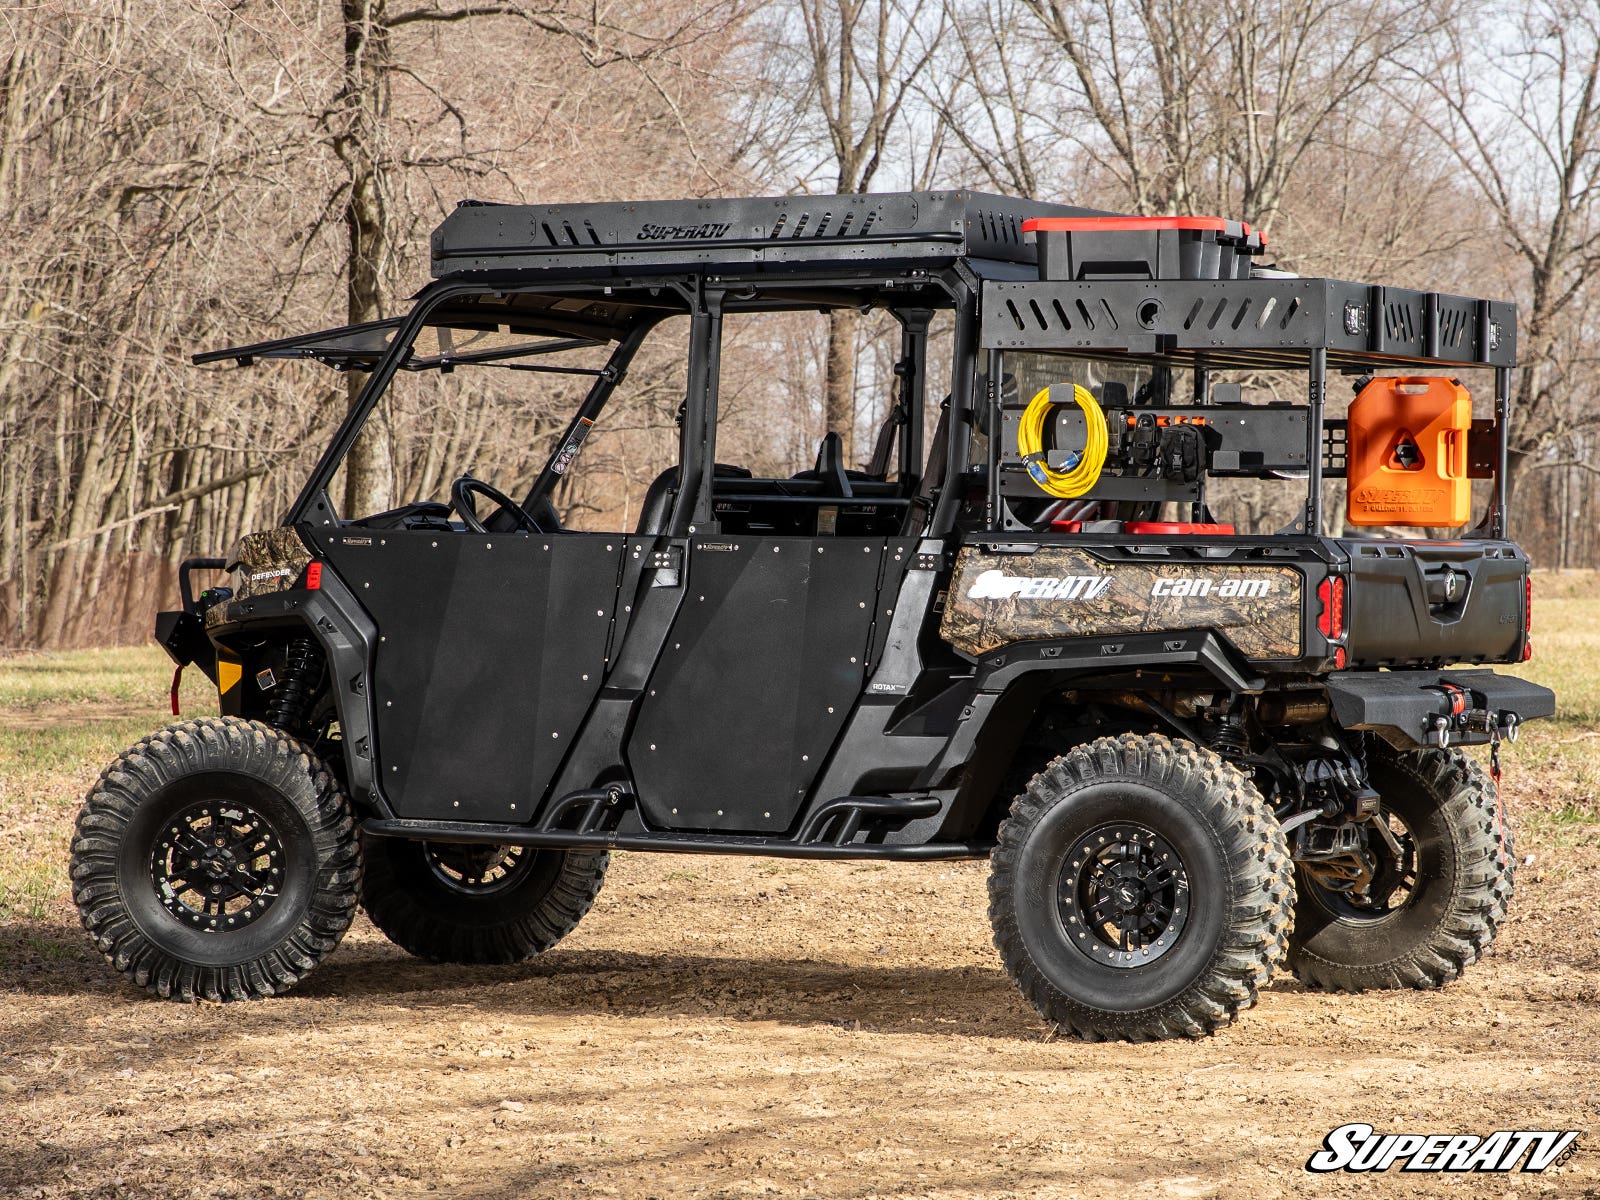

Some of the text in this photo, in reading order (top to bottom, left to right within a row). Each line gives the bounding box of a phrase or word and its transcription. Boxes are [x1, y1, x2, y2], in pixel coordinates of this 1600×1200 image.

[637, 223, 733, 240] SUPERATV
[251, 569, 291, 581] DEFENDER
[967, 570, 1113, 600] PERATV
[1151, 578, 1271, 597] can-am
[873, 683, 896, 691] ROTAX
